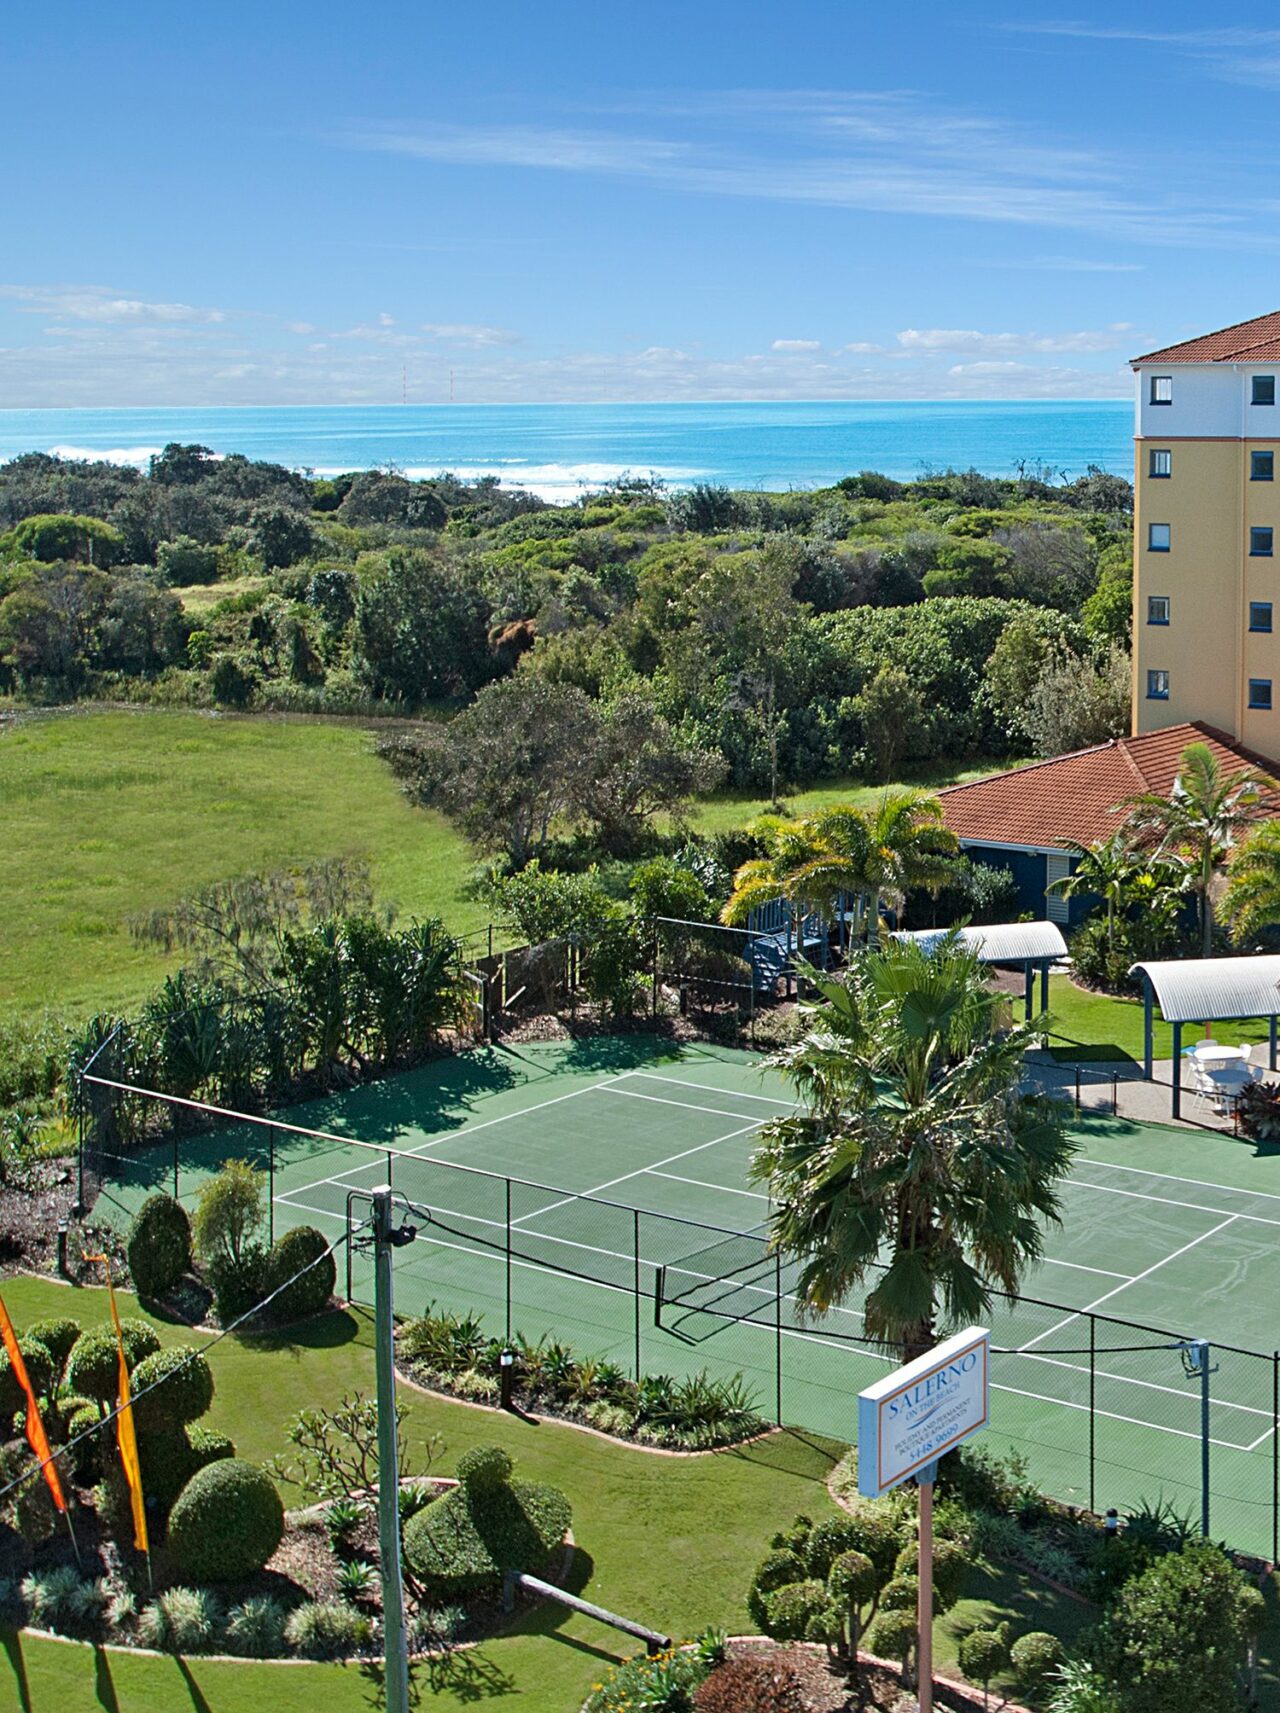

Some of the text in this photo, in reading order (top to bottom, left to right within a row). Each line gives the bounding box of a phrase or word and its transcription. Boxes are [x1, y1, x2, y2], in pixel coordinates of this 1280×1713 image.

[889, 1353, 976, 1420] SALERNO
[906, 1382, 960, 1421] ON THE BEACH
